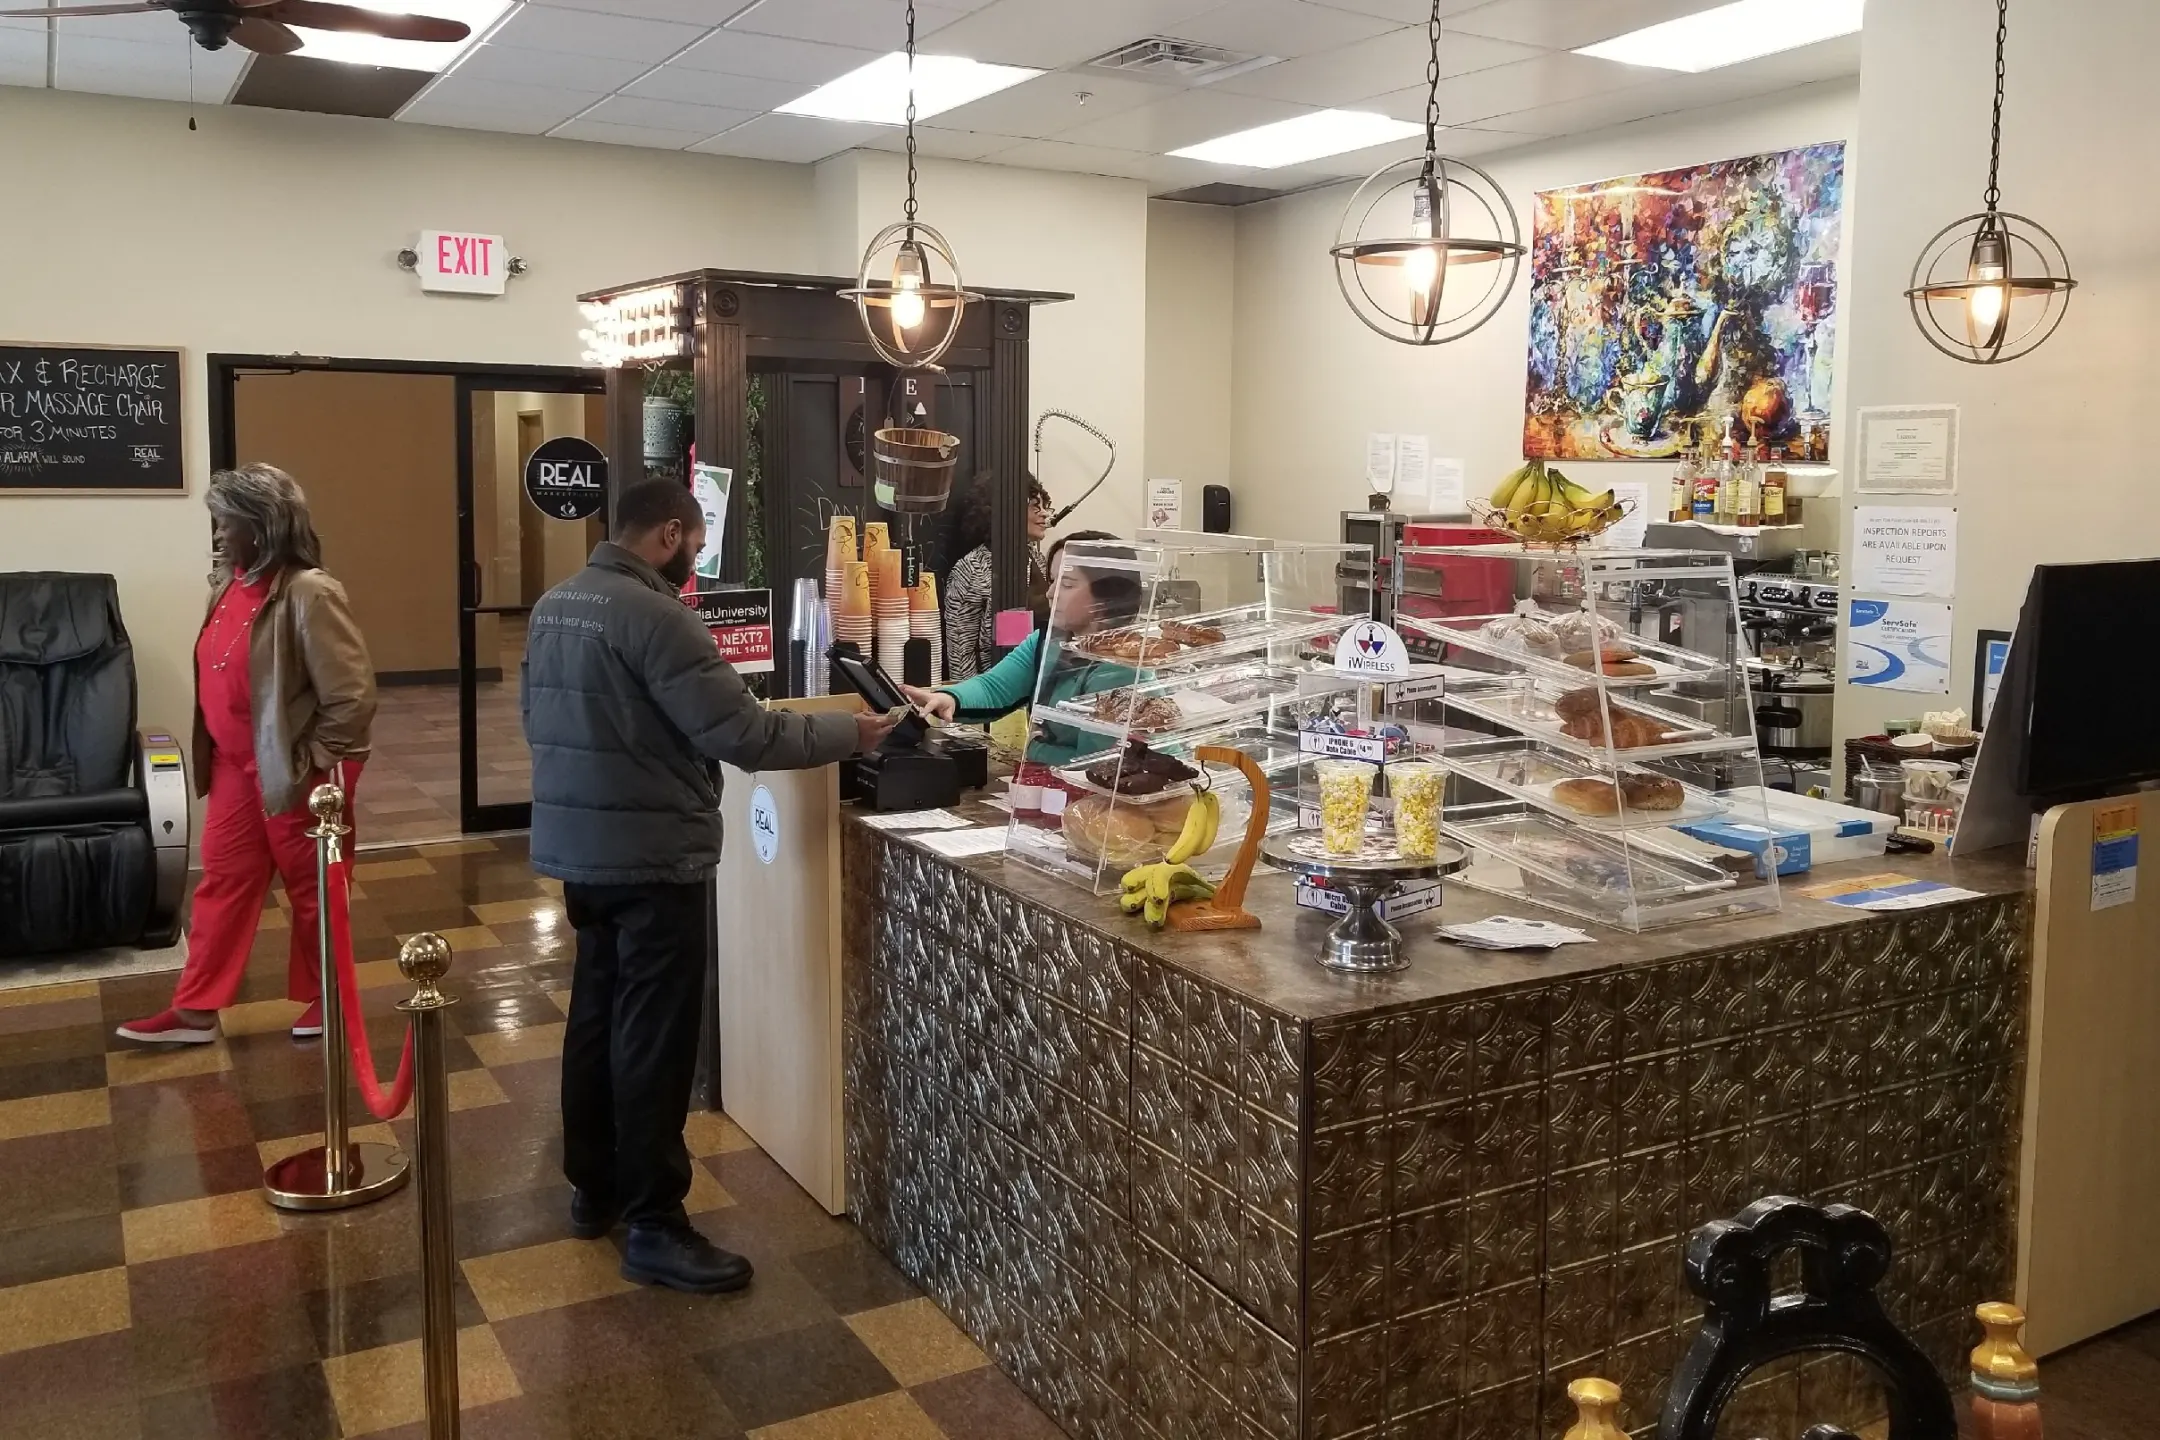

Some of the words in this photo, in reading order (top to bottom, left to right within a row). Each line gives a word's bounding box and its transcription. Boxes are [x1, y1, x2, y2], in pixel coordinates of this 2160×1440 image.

[438, 235, 493, 276] EXIT
[59, 358, 166, 394] RECHARGE
[25, 390, 112, 422] MASSAGE
[30, 420, 45, 443] 3
[49, 425, 117, 442] MINUTES
[4, 451, 39, 463] ALARM
[42, 455, 58, 464] WILL
[63, 455, 86, 464] SOUND
[134, 448, 161, 458] REAL
[540, 462, 601, 488] REAL
[1863, 527, 1910, 536] INSPECTION
[1911, 528, 1948, 538] REPORTS
[1862, 540, 1877, 549] ARE
[1878, 540, 1921, 550] AVAILABLE
[1923, 542, 1947, 551] UPON
[1885, 554, 1922, 564] REQUEST
[905, 545, 916, 587] TIPS
[722, 631, 764, 646] NEXT?
[719, 646, 743, 657] PRIL
[744, 644, 769, 654] 14TH
[1340, 746, 1357, 755] Cable
[755, 808, 775, 835] REAL
[1324, 891, 1341, 902] Micro
[1330, 901, 1347, 911] Cable
